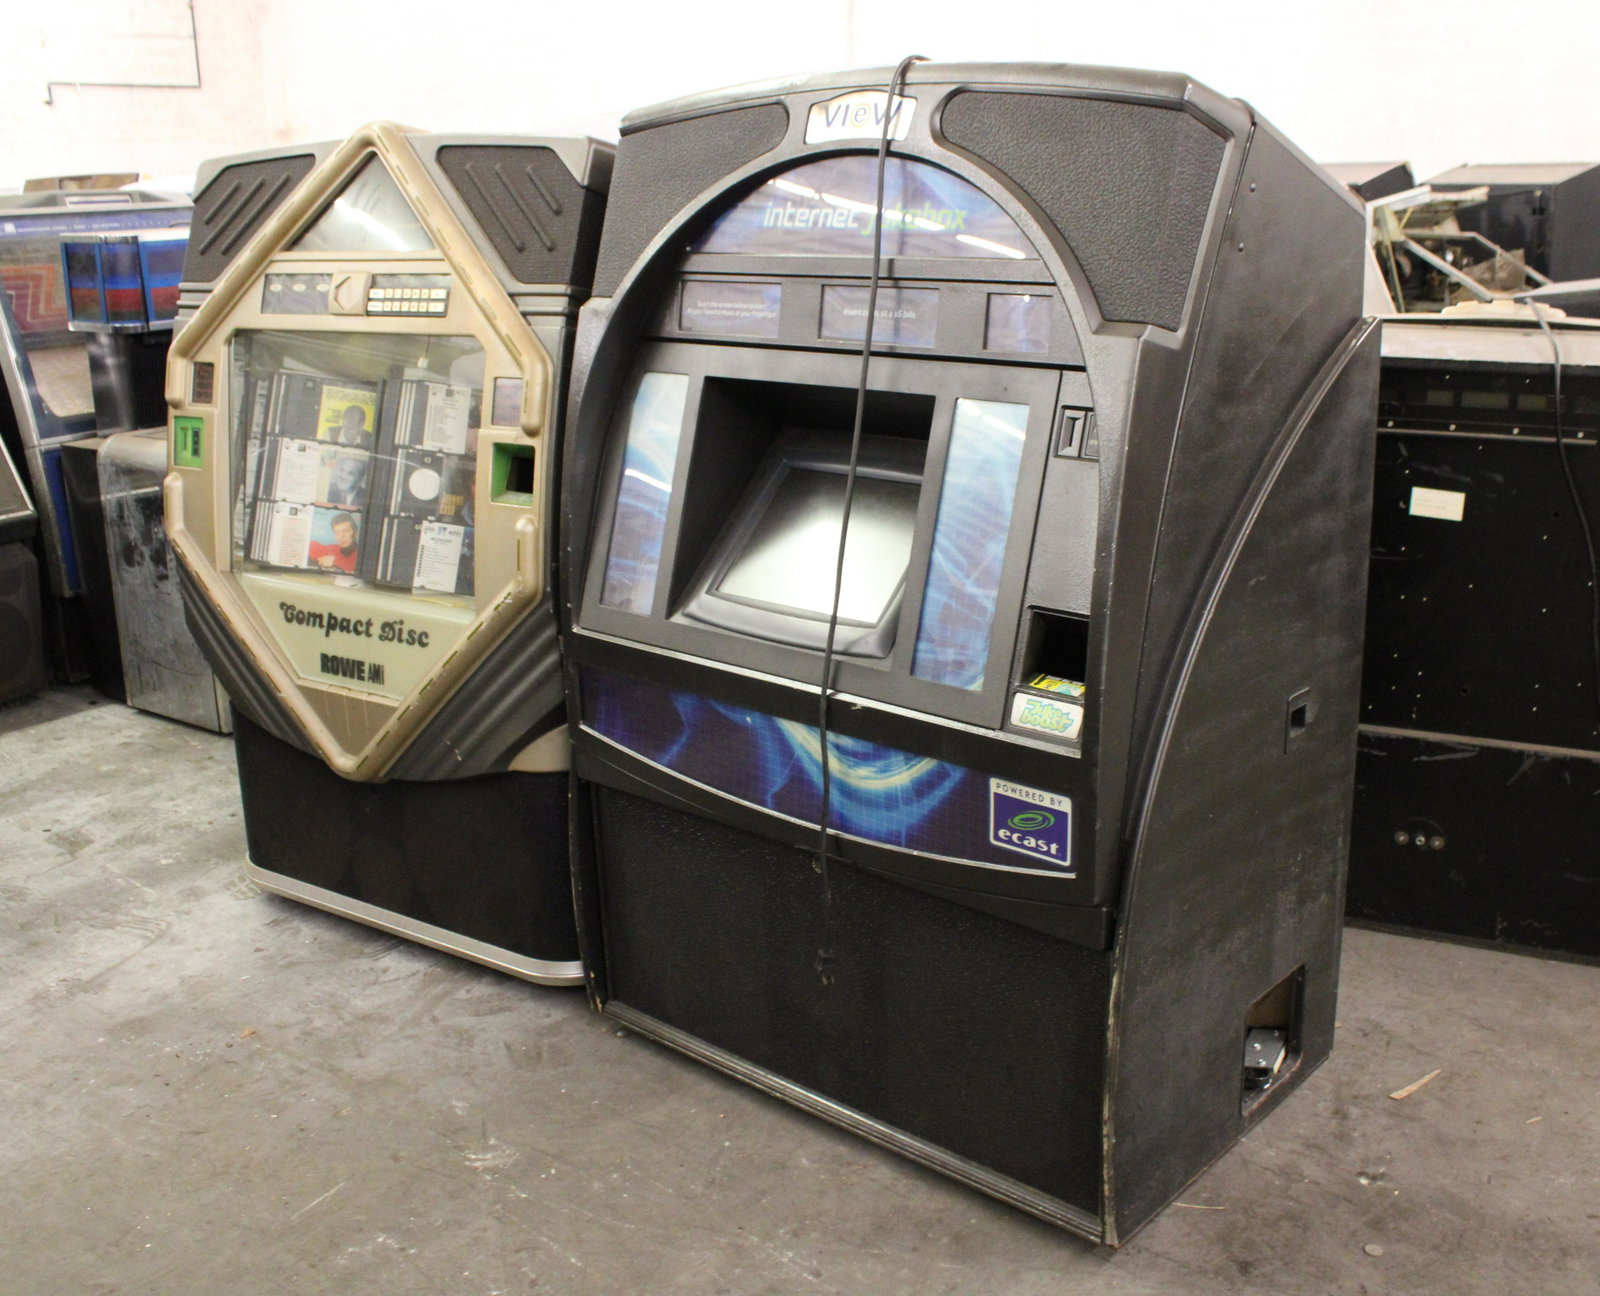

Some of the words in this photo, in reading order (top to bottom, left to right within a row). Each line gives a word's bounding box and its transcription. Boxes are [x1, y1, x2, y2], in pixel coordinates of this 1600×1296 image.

[763, 201, 858, 229] internet
[279, 601, 373, 638] Compact
[378, 619, 430, 648] Disc
[320, 652, 365, 682] ROWE
[996, 782, 1044, 802] POWERED
[1050, 797, 1062, 807] BY
[998, 829, 1059, 855] ecast
